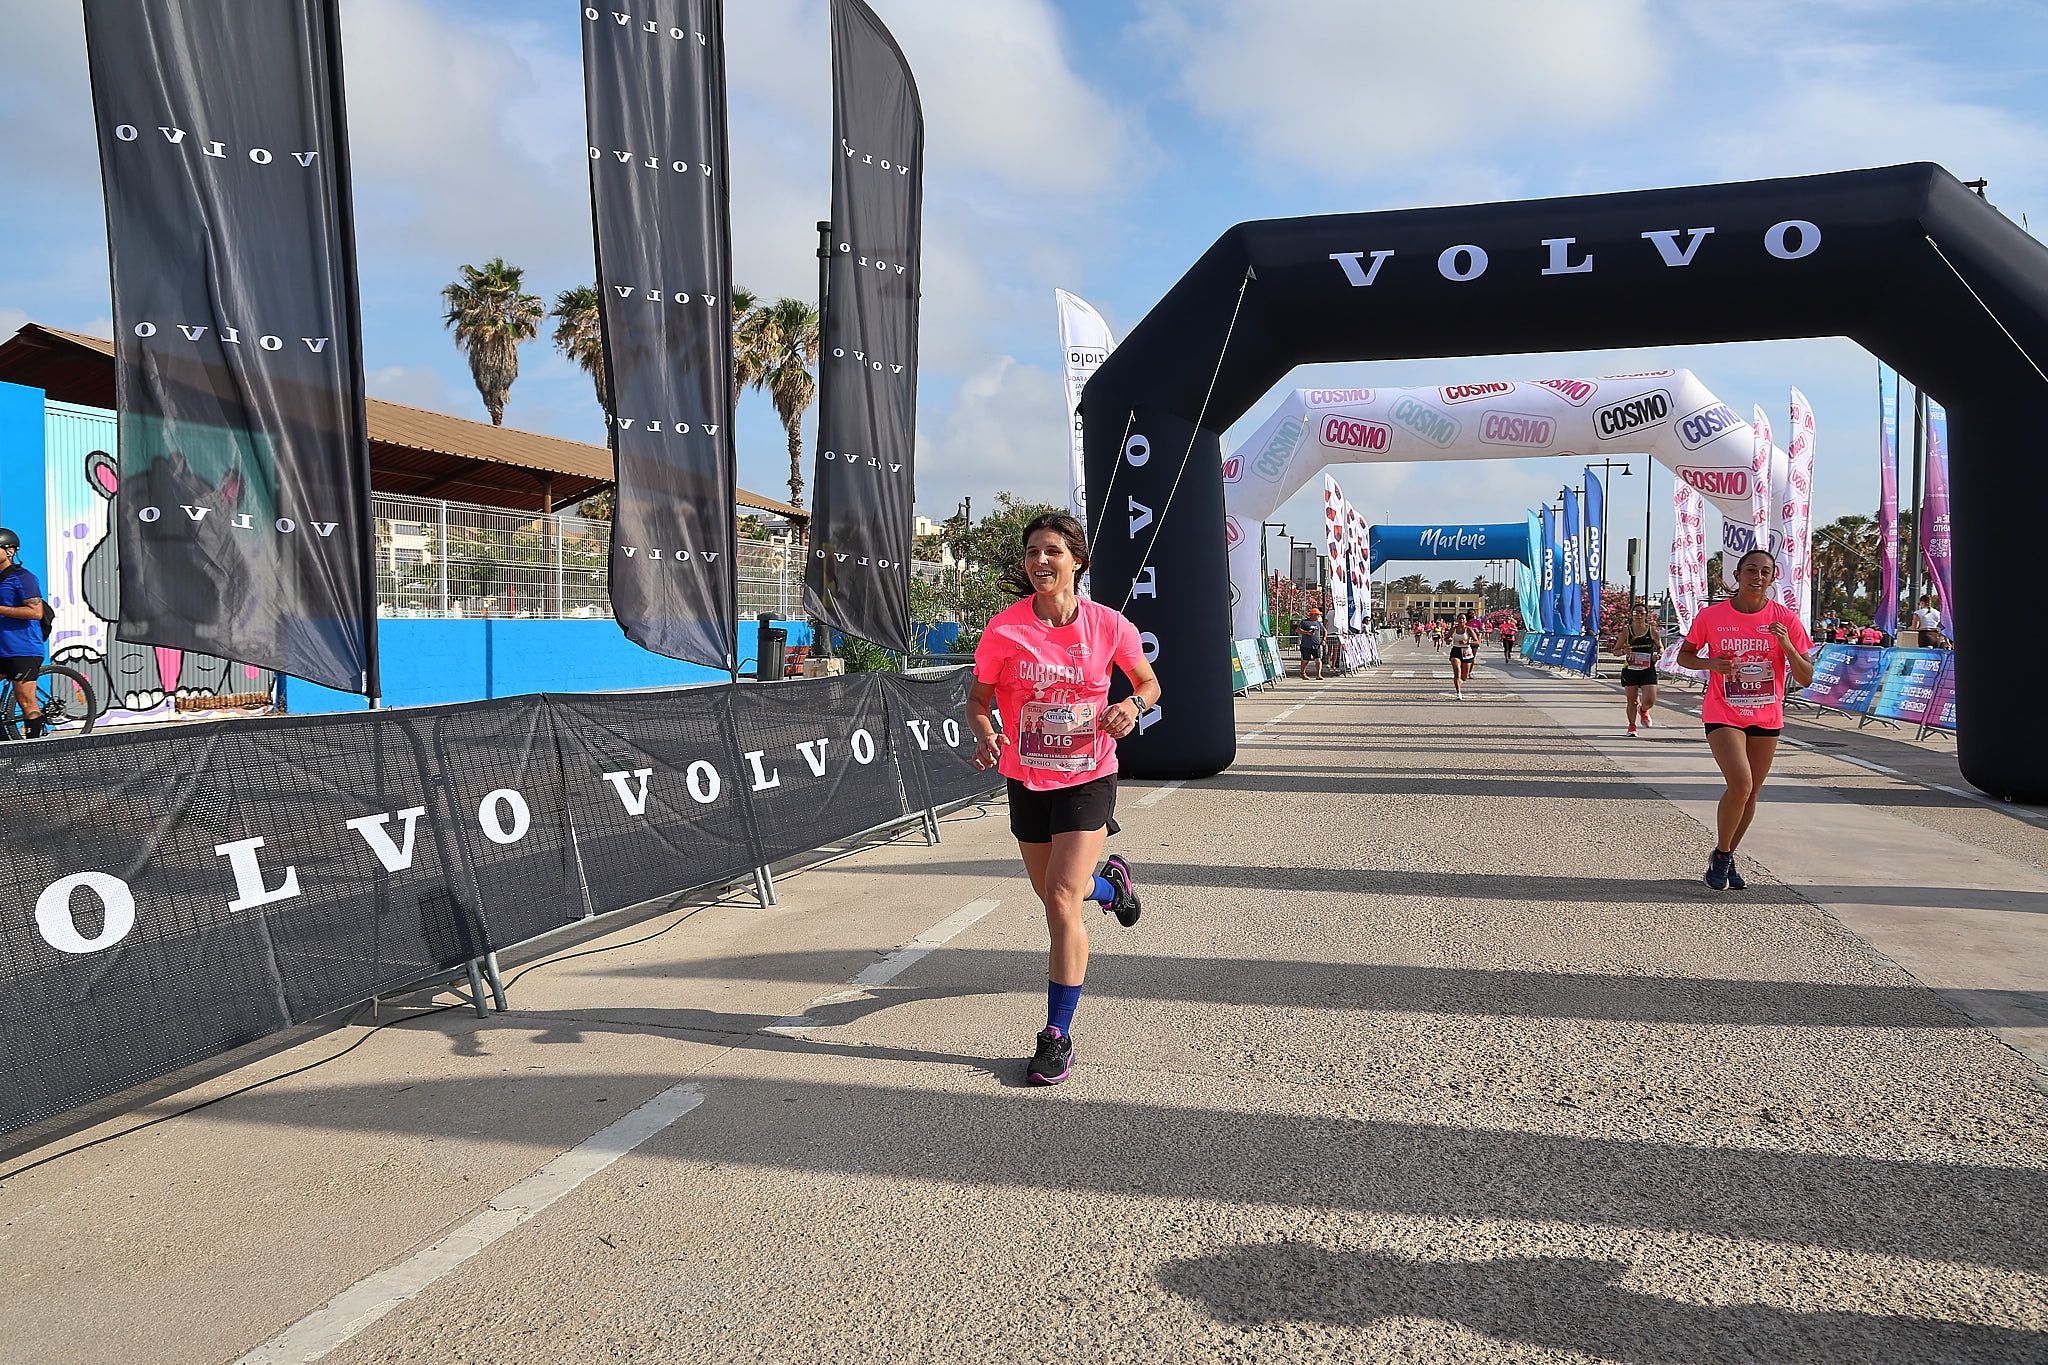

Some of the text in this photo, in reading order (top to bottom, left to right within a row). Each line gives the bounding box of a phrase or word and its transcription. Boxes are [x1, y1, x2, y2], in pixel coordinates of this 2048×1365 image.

[1329, 220, 1822, 287] VOLVO
[1310, 388, 1370, 405] COSMO
[1445, 382, 1508, 400] COSMO
[1395, 399, 1456, 444] COSMO
[1485, 414, 1550, 445] COSMO
[1600, 394, 1668, 435] COSMO
[1683, 405, 1740, 444] COSMO
[1257, 420, 1304, 477] COSMO
[1326, 418, 1387, 450] COSMO
[1682, 469, 1748, 497] COSMO
[1419, 527, 1486, 556] Marlene
[1721, 639, 1770, 652] CARRERA
[1020, 660, 1086, 686] CARRERA
[1741, 681, 1762, 690] 016
[1043, 734, 1073, 747] 016
[602, 727, 876, 817] VOLVO
[34, 787, 532, 954] OLVO
